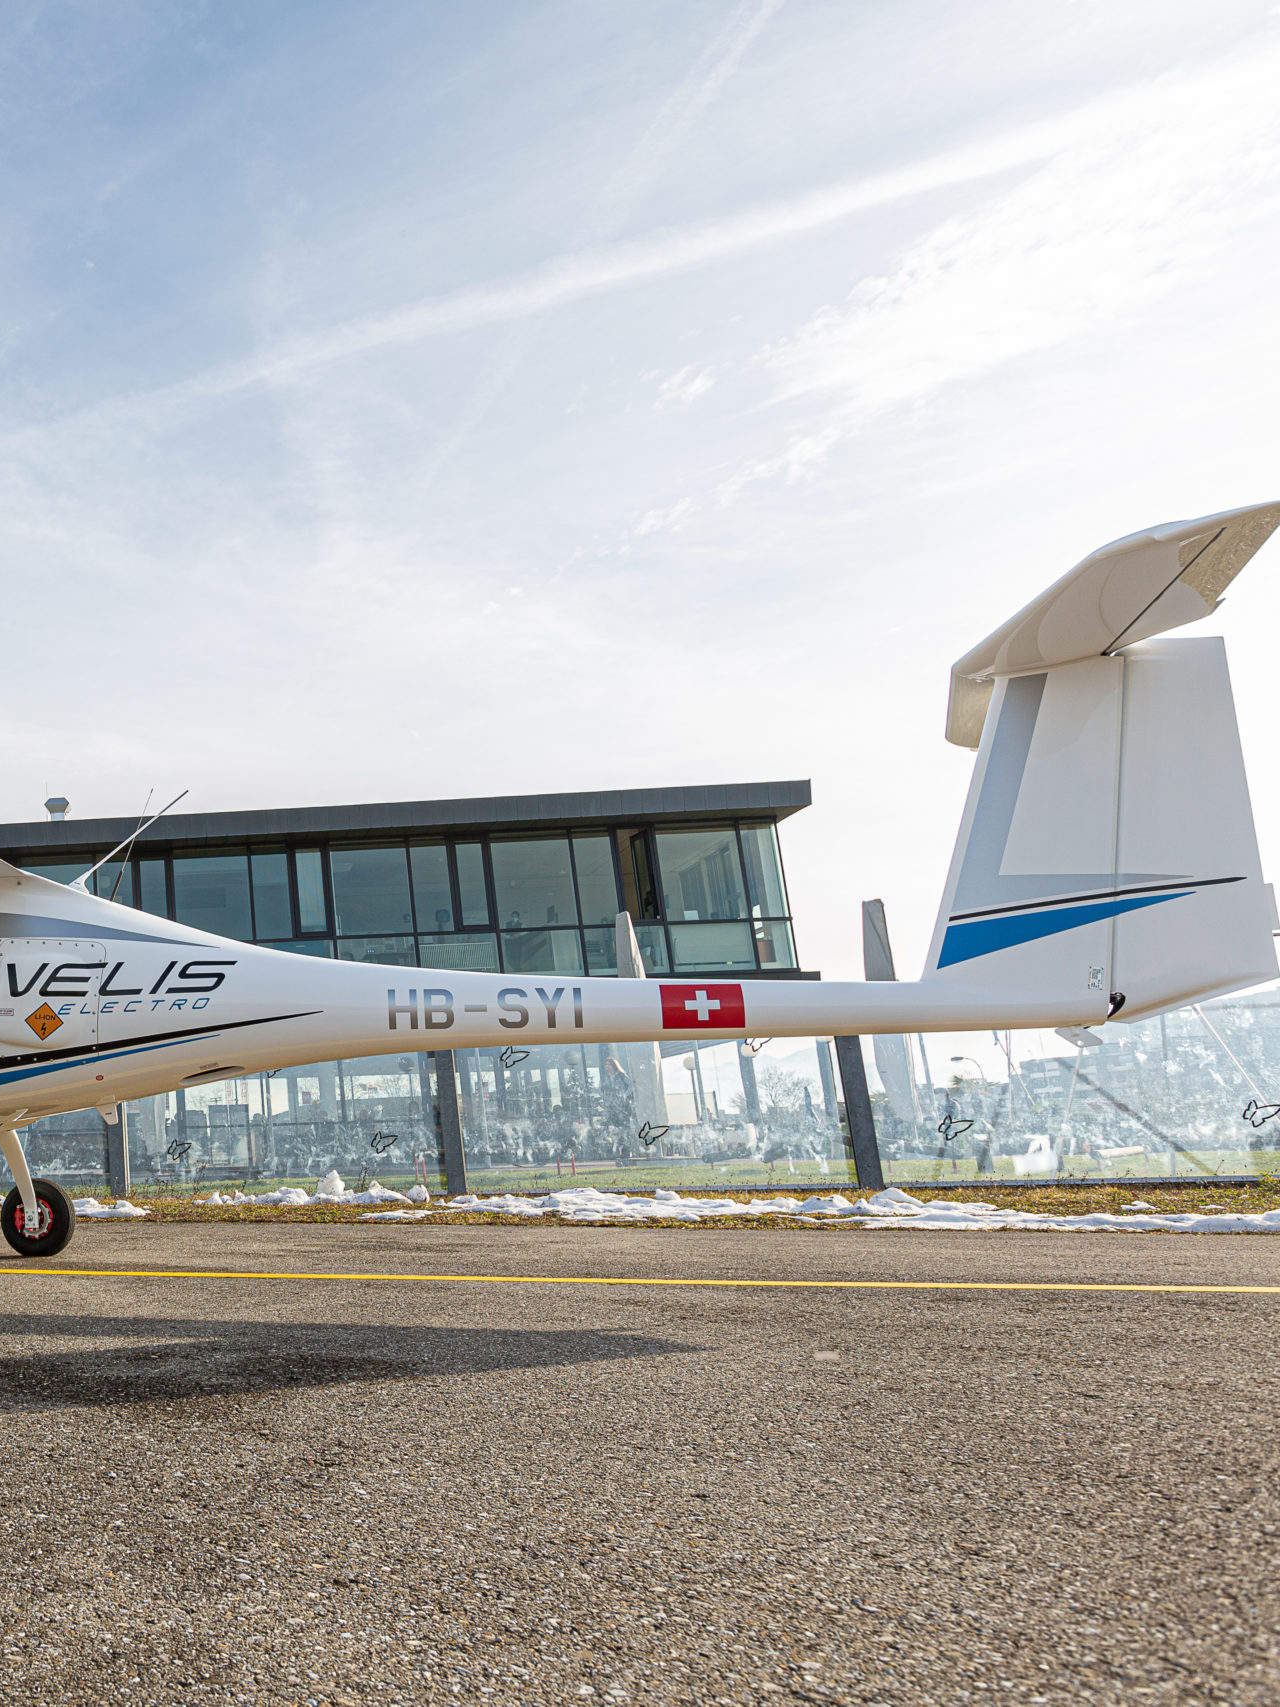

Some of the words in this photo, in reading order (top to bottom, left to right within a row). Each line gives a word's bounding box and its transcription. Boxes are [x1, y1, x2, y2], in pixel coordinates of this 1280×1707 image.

[7, 961, 238, 997] VELIS
[34, 1013, 56, 1021] LI-ION
[57, 997, 211, 1016] ELECTRO
[387, 987, 584, 1030] HB-SYI
